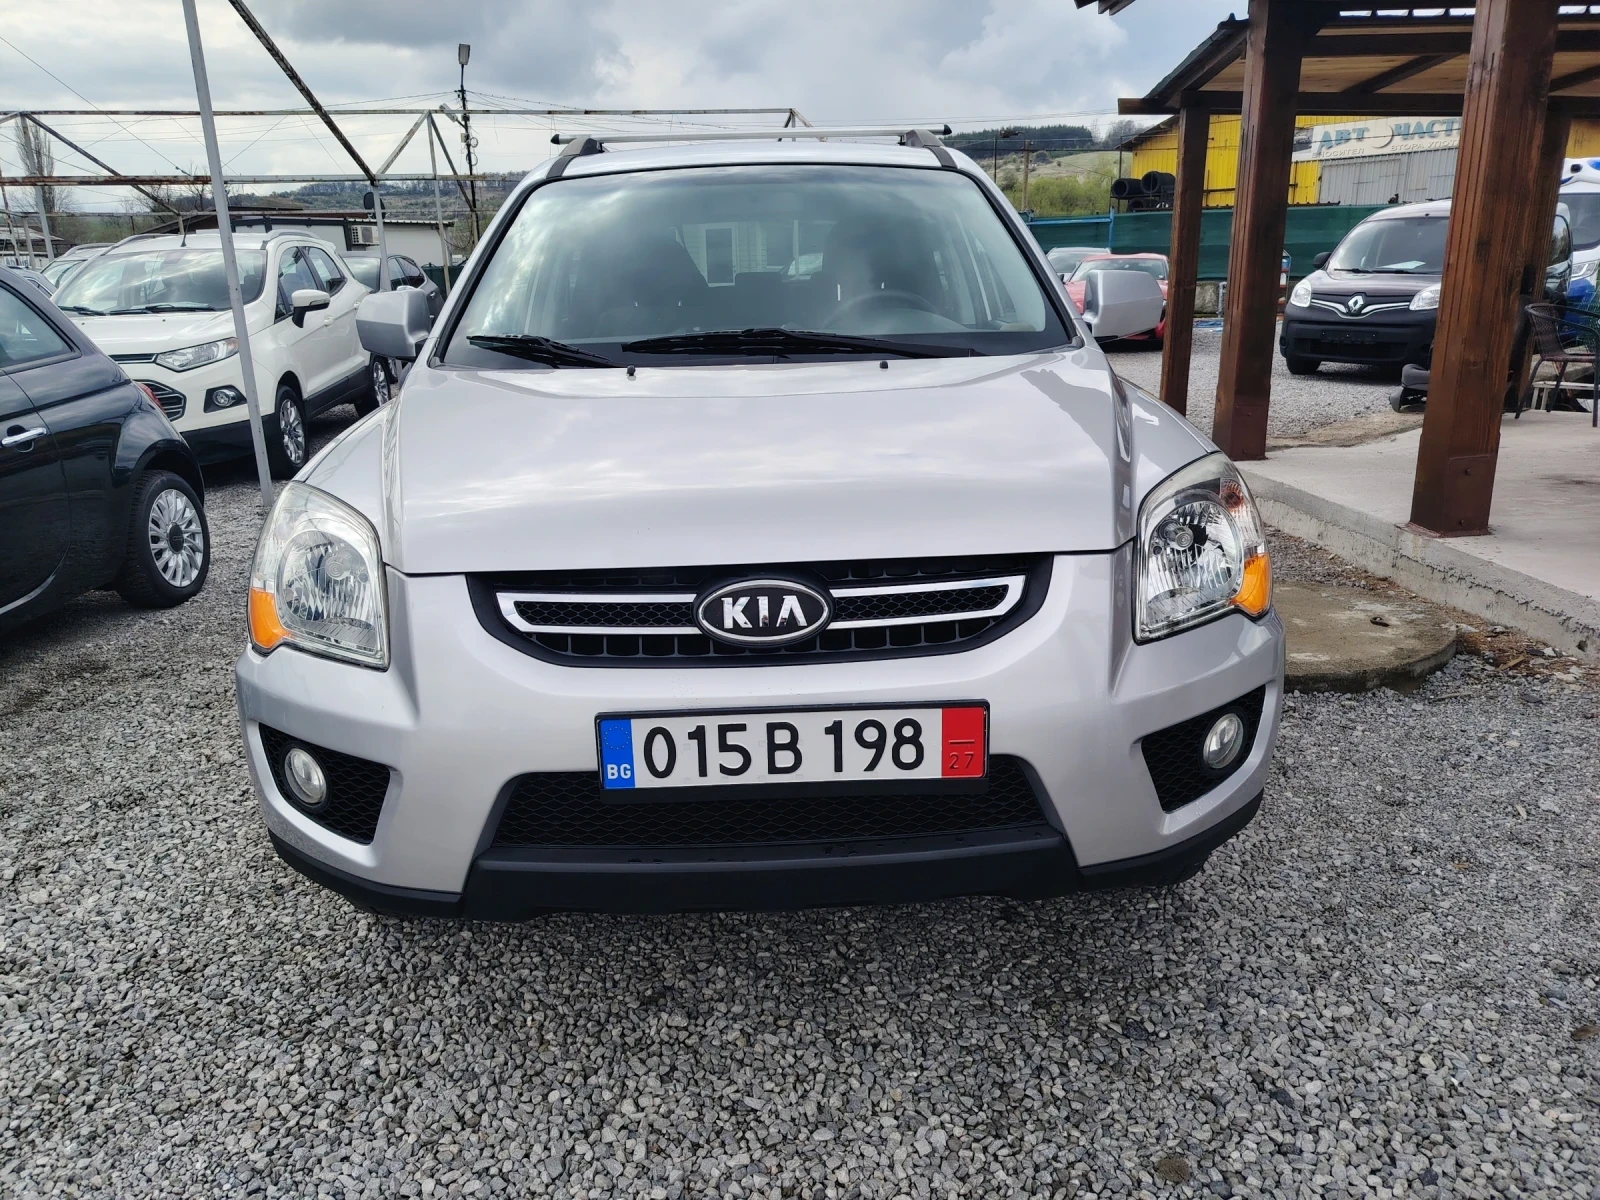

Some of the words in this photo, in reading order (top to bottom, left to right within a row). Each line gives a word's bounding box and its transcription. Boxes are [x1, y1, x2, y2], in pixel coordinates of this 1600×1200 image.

[1390, 143, 1424, 152] ВТОРА
[1427, 139, 1459, 150] УПОТ
[720, 594, 808, 629] KIA
[824, 717, 925, 773] 198
[948, 751, 975, 770] 27
[606, 763, 632, 780] BG
